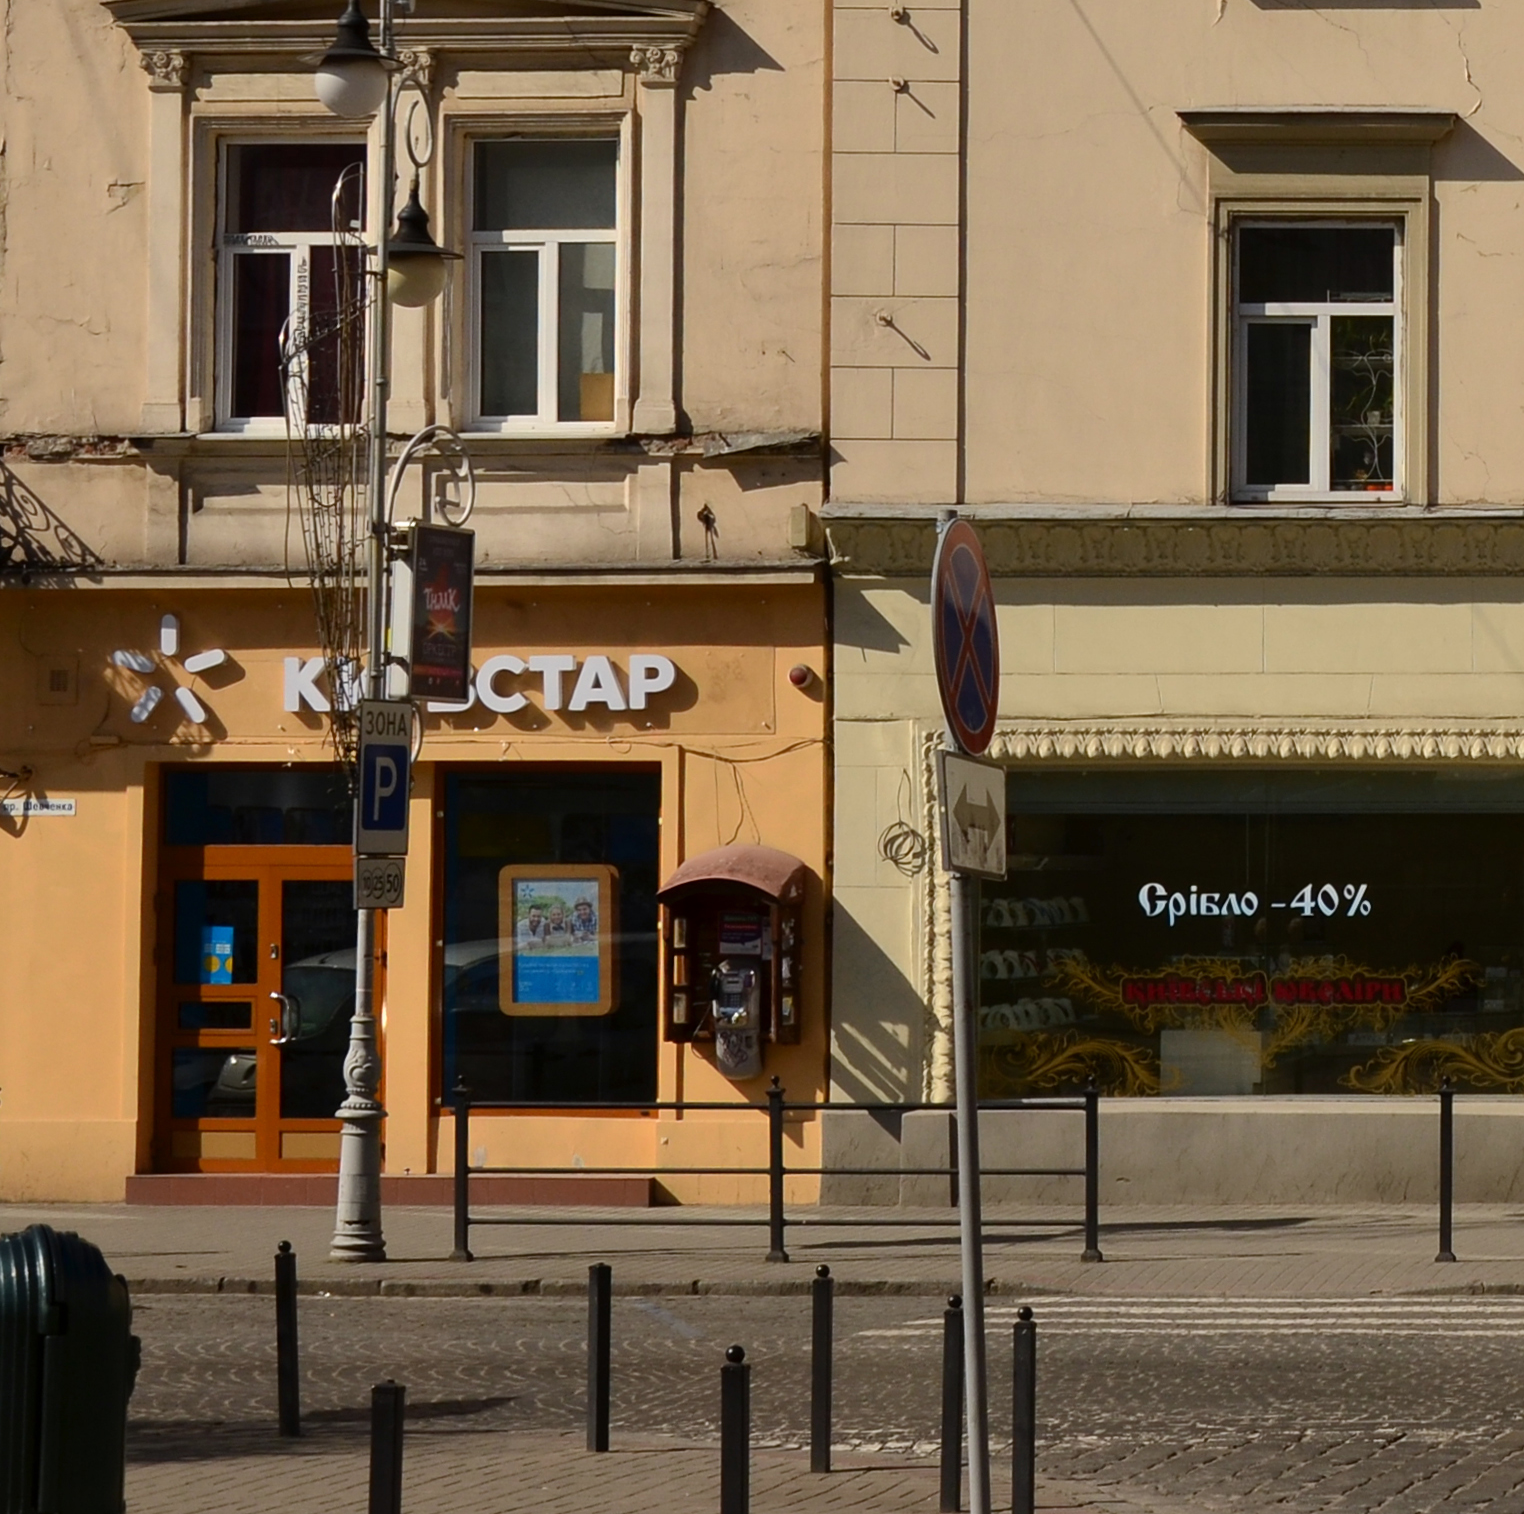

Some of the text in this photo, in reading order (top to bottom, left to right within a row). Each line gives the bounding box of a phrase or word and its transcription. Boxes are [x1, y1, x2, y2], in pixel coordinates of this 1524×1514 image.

[365, 711, 408, 737] ЗОНА
[373, 756, 398, 822] P
[374, 875, 383, 891] 25
[387, 873, 400, 893] 50
[1138, 882, 1372, 927] Срібло -40%
